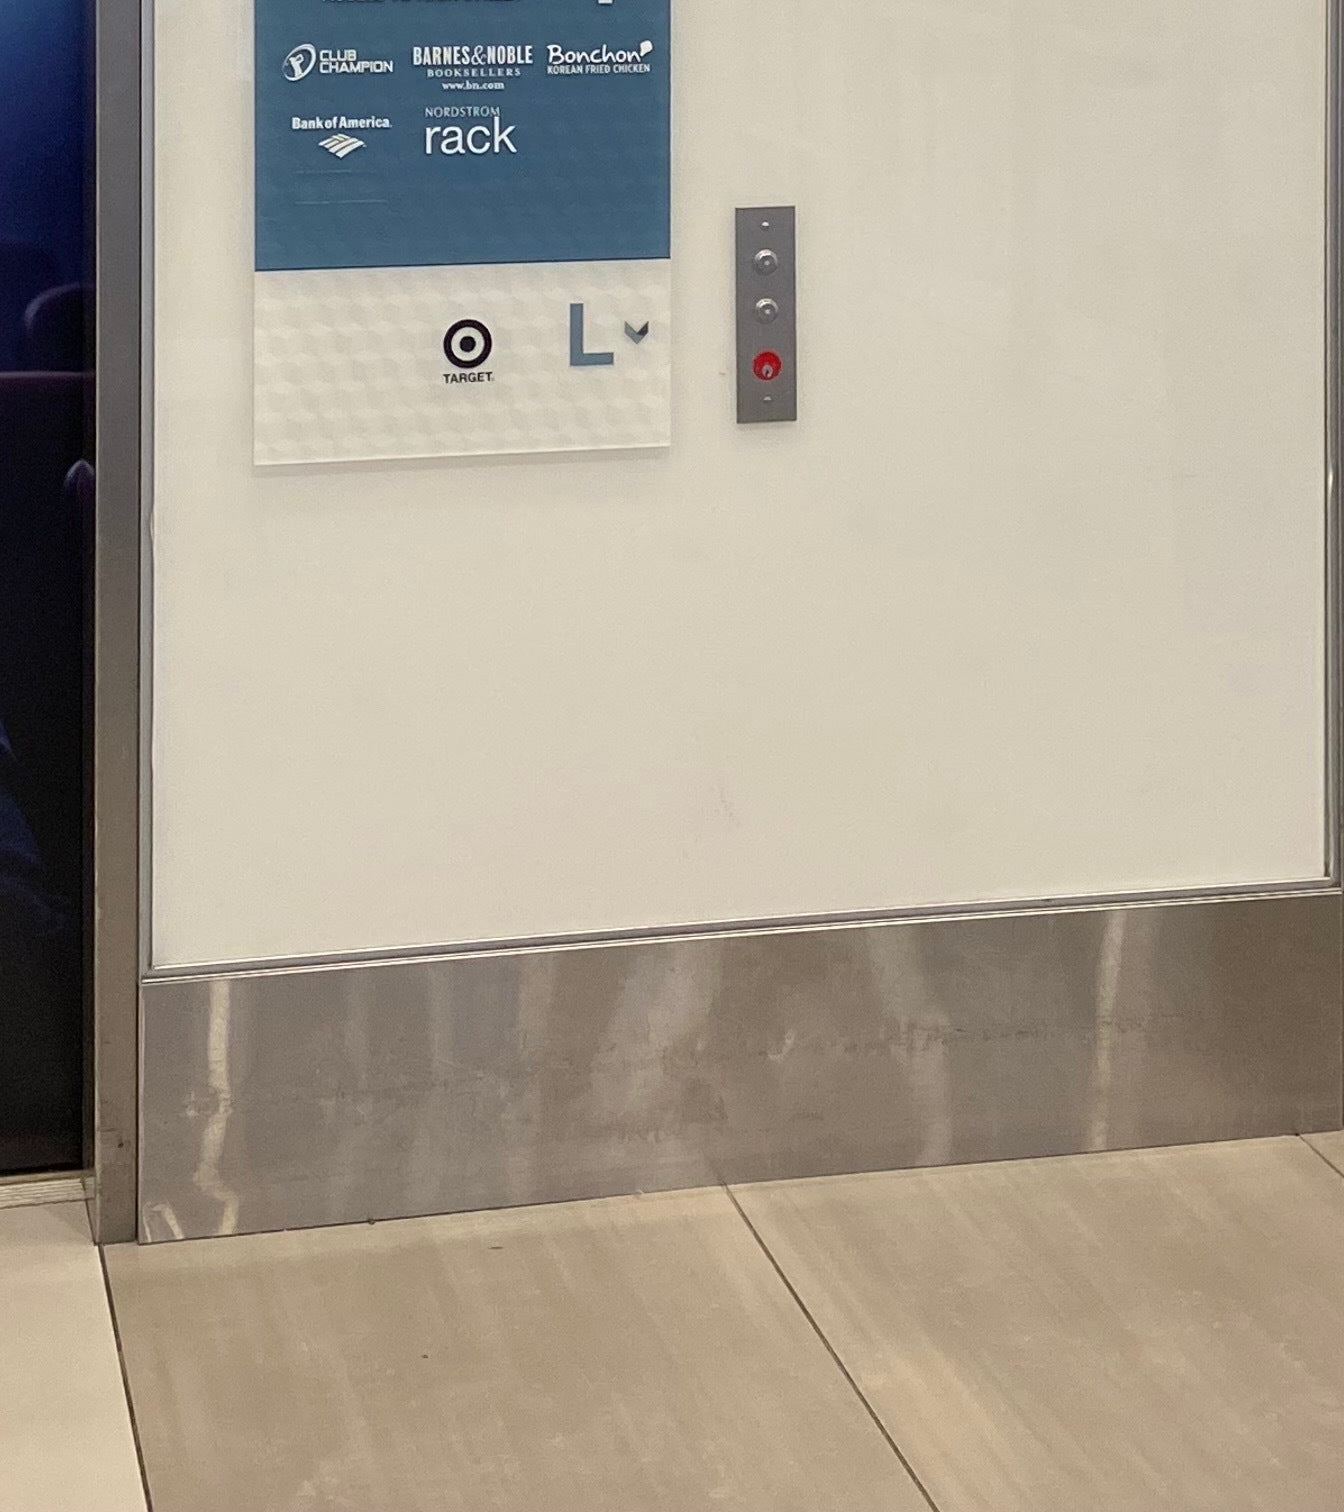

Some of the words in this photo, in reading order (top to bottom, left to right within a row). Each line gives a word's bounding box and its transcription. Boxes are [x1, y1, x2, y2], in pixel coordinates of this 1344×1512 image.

[319, 49, 358, 62] CLUB
[546, 44, 642, 65] Bonchon
[319, 60, 395, 74] CHAMPION
[426, 67, 522, 78] BOOKSELLERS
[546, 64, 584, 76] KOREAN
[584, 63, 611, 75] FRIED
[612, 63, 651, 74] CHICKEN
[441, 80, 505, 90] www.bn.com
[424, 105, 501, 118] NORDSTROM
[291, 116, 324, 130] Bank
[324, 116, 338, 129] of
[424, 115, 518, 155] rack
[569, 303, 615, 367] L
[443, 371, 493, 384] TARGET
